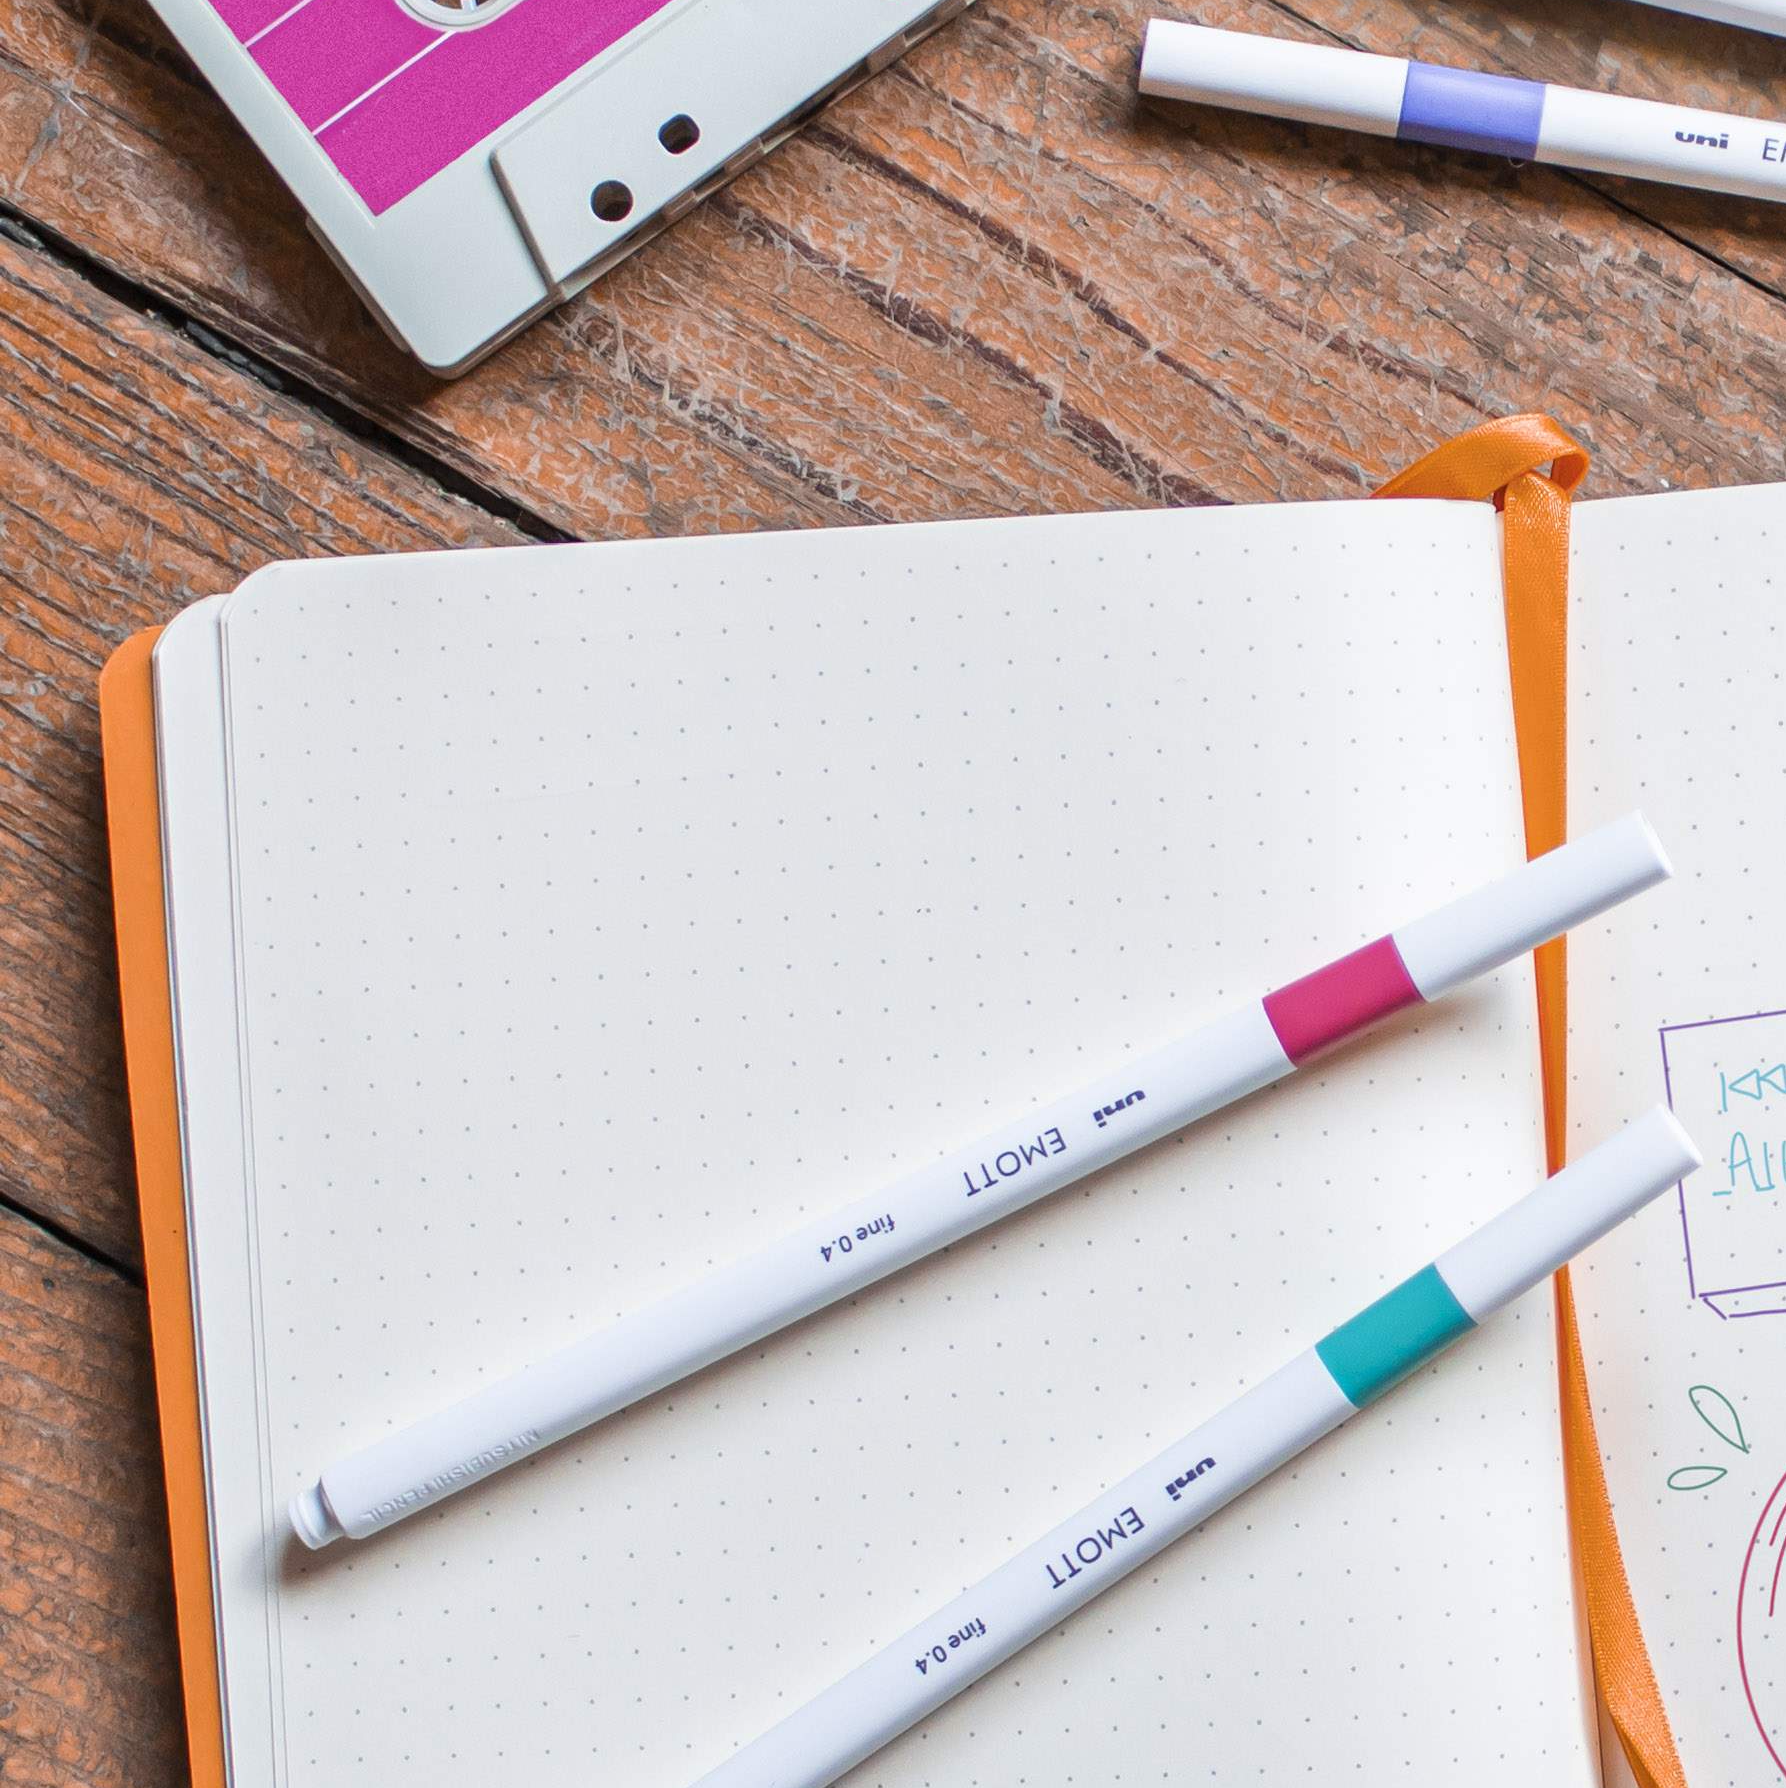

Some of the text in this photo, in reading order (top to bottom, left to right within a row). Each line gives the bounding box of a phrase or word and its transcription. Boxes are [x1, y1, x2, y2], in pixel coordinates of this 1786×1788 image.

[1675, 130, 1729, 150] uni
[820, 1090, 1146, 1263] uni EMOTT fine 0.4
[915, 1457, 1217, 1675] uni EMOTT fine 0.4
